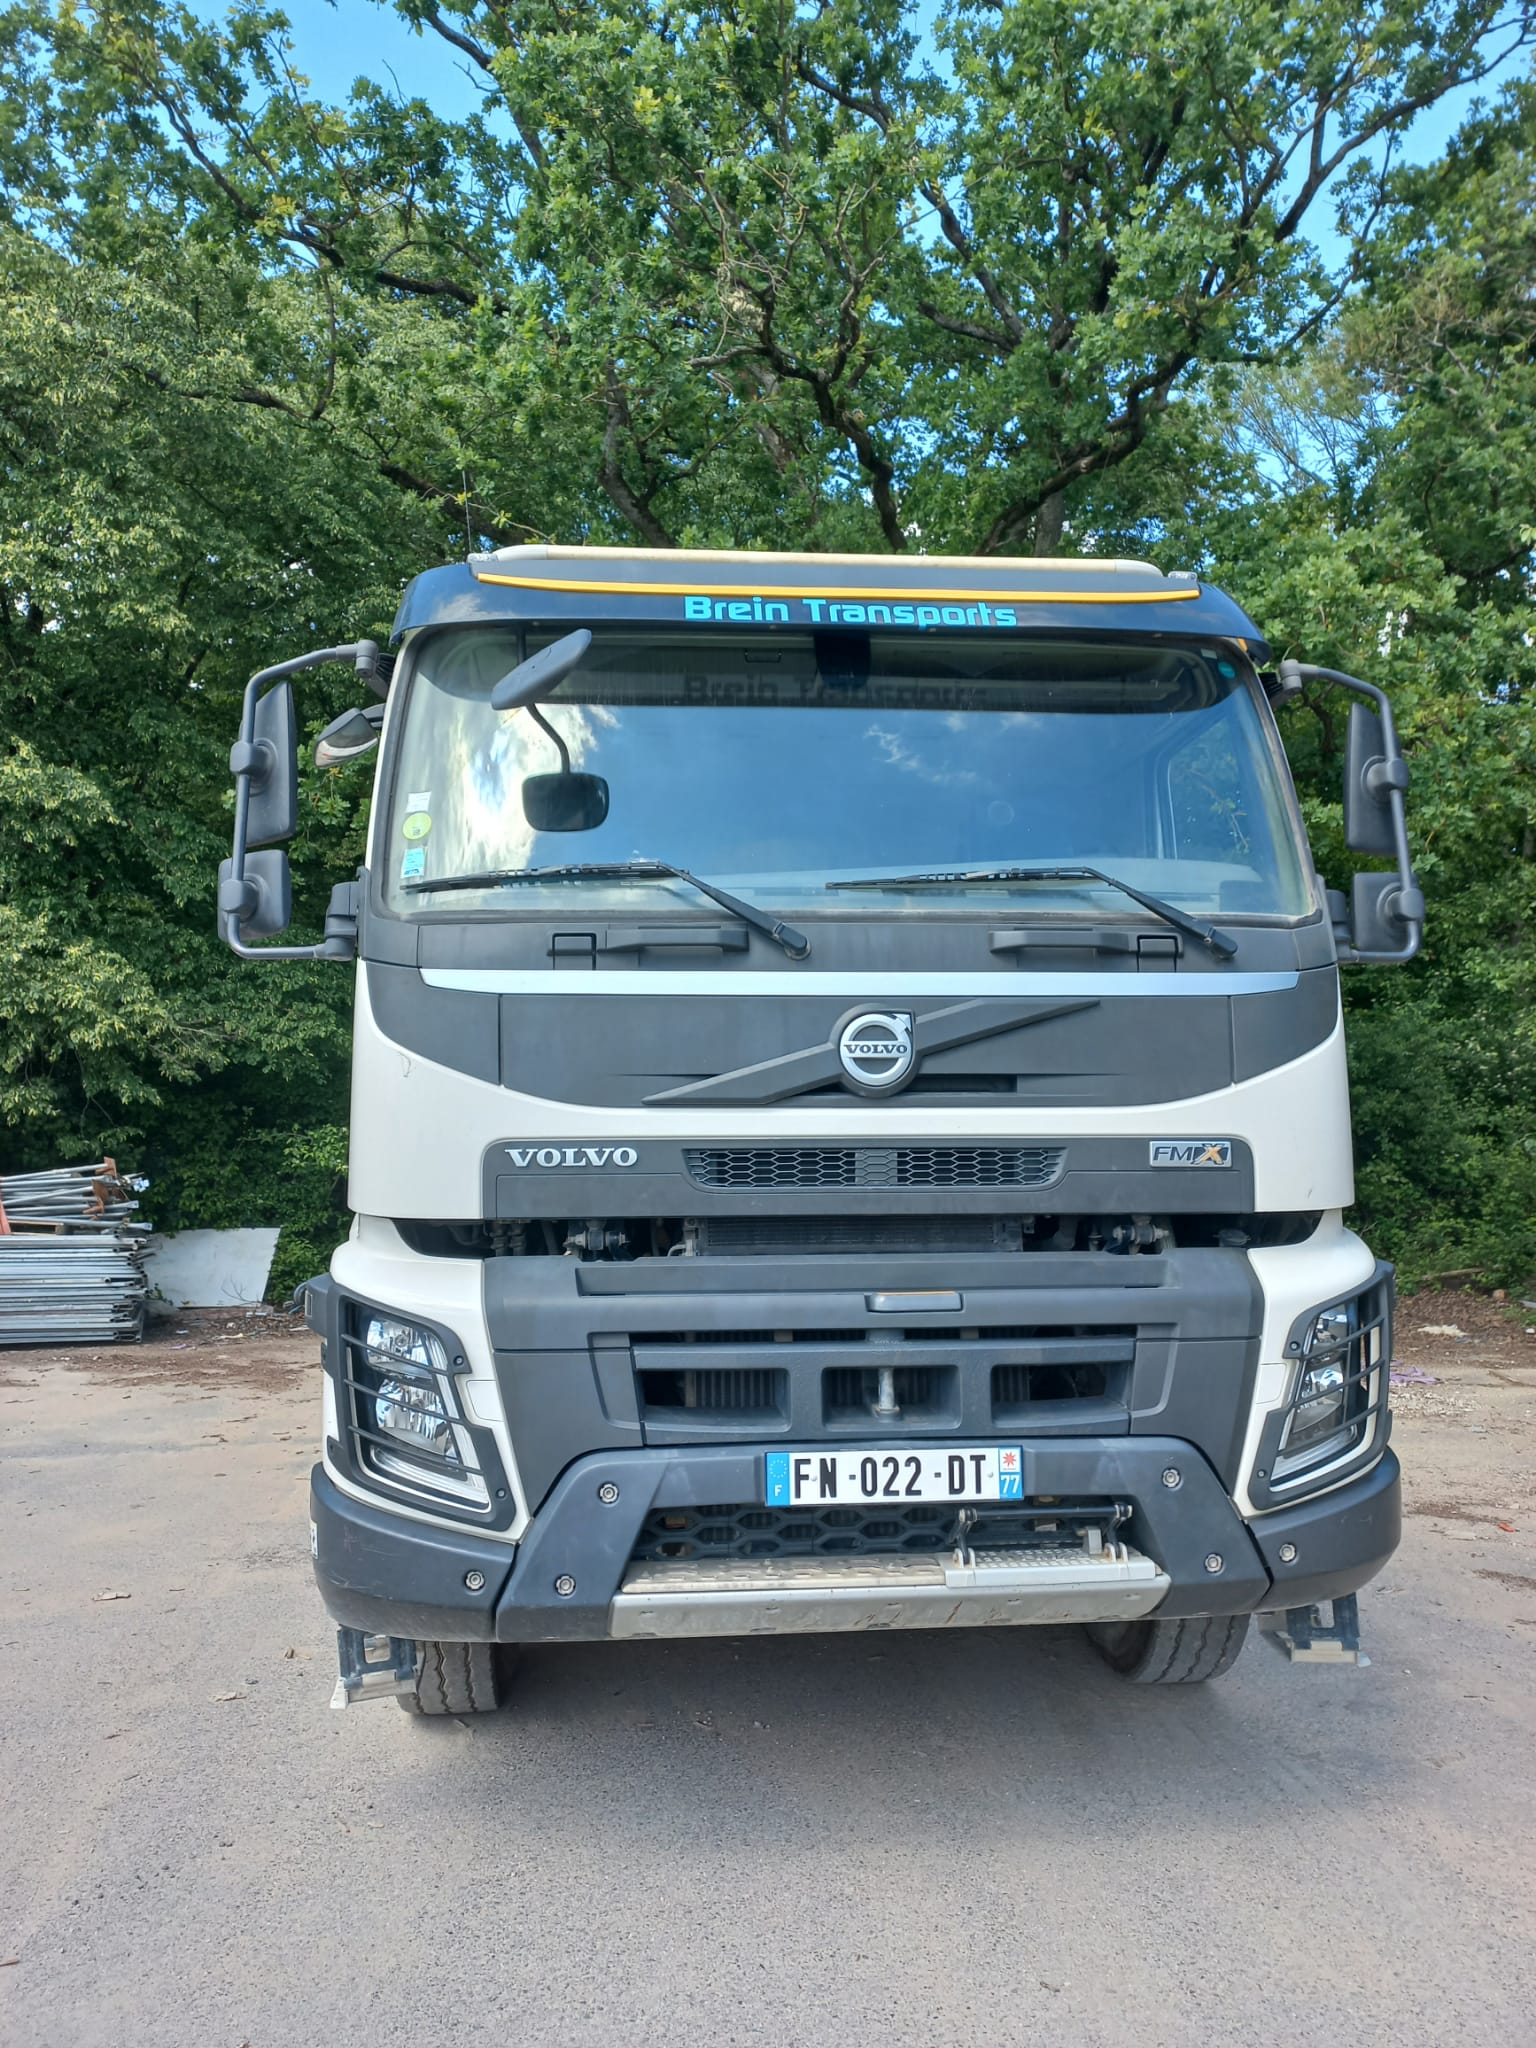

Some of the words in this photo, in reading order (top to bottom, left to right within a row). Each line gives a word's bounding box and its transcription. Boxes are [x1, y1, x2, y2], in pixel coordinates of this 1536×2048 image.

[684, 595, 789, 622] Brein
[802, 598, 1017, 631] Transports
[843, 1044, 908, 1054] VOLVO
[504, 1147, 638, 1167] VOLVO
[1153, 1143, 1227, 1165] FMX
[774, 1484, 782, 1497] F
[1000, 1474, 1020, 1494] 77
